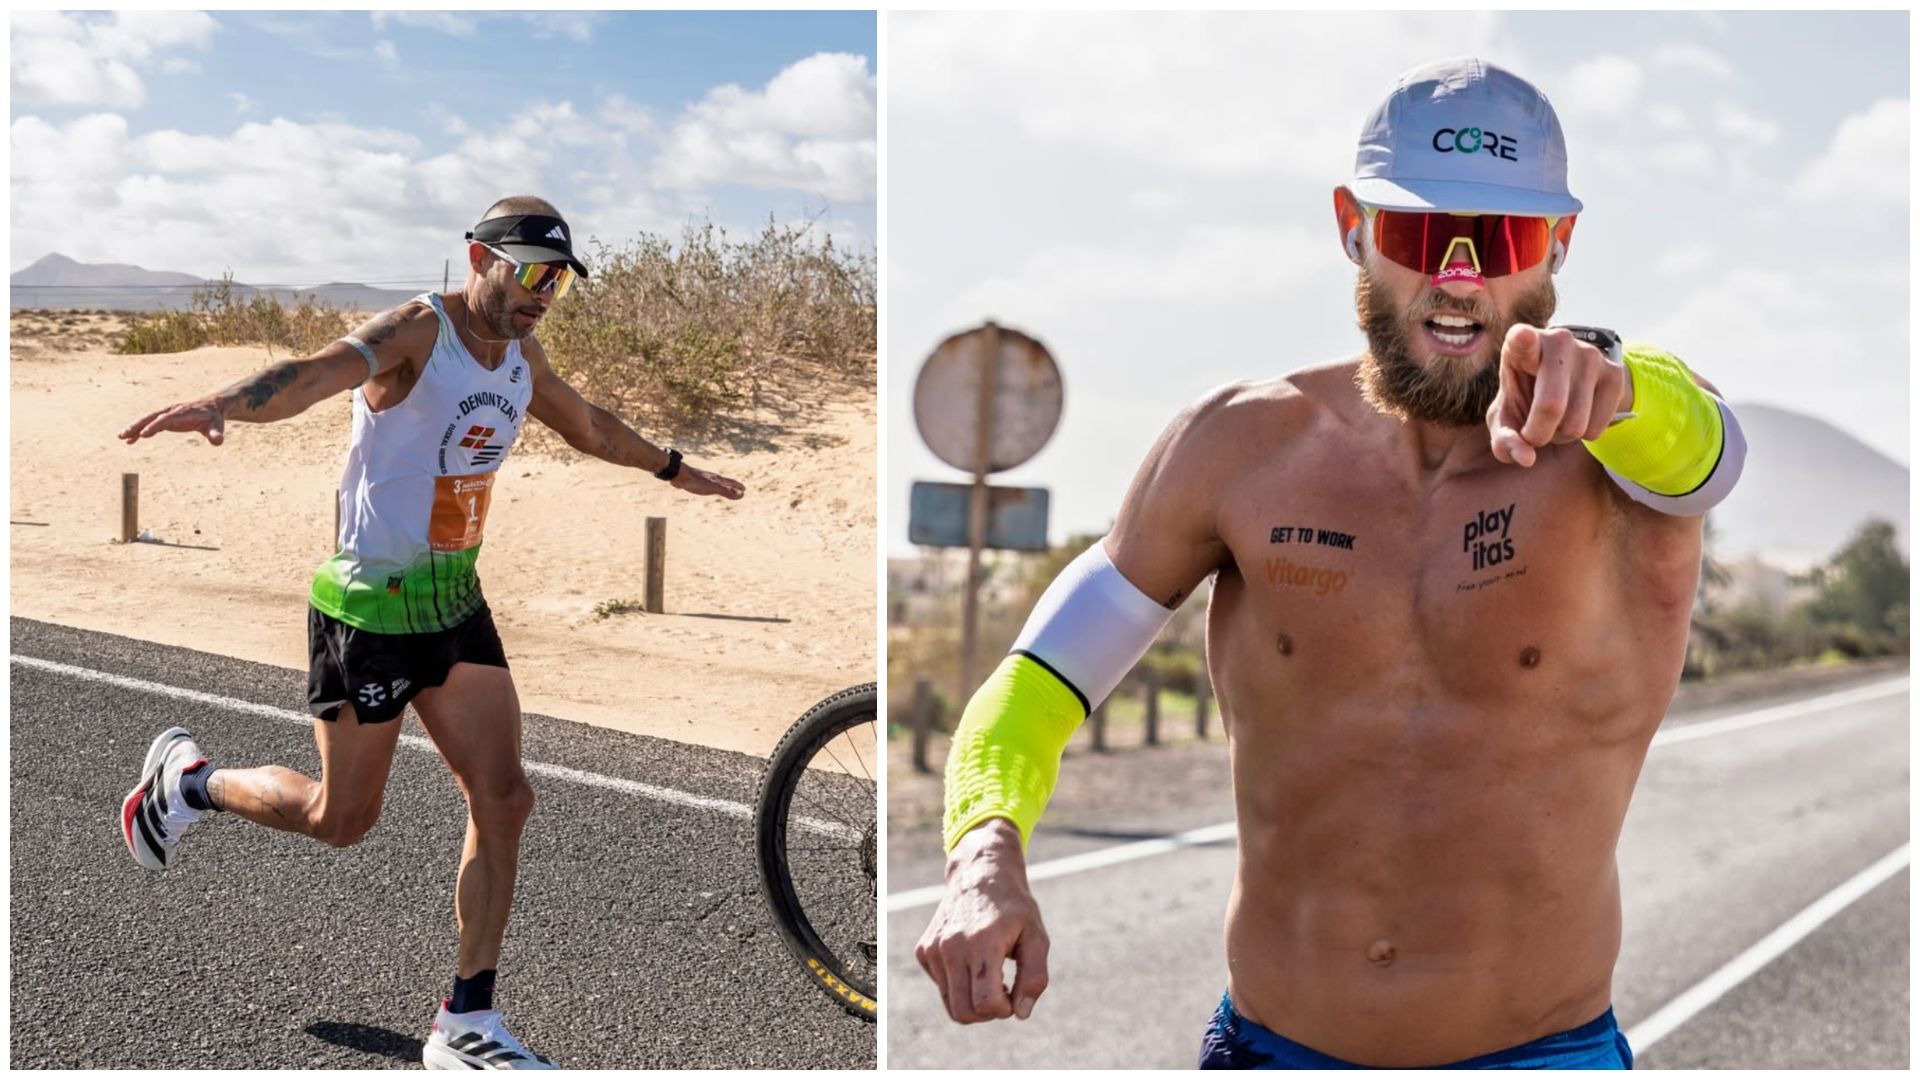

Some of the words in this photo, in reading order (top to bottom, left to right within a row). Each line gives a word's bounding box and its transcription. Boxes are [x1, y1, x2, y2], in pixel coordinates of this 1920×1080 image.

[1432, 127, 1518, 162] CORE
[458, 391, 518, 423] DENONTZAT
[468, 495, 478, 521] 1
[1270, 527, 1294, 544] GET
[1297, 527, 1314, 544] TO
[1317, 528, 1356, 551] WORK
[1463, 502, 1516, 553] play
[1473, 538, 1514, 571] itas
[1265, 555, 1348, 597] Vitargo
